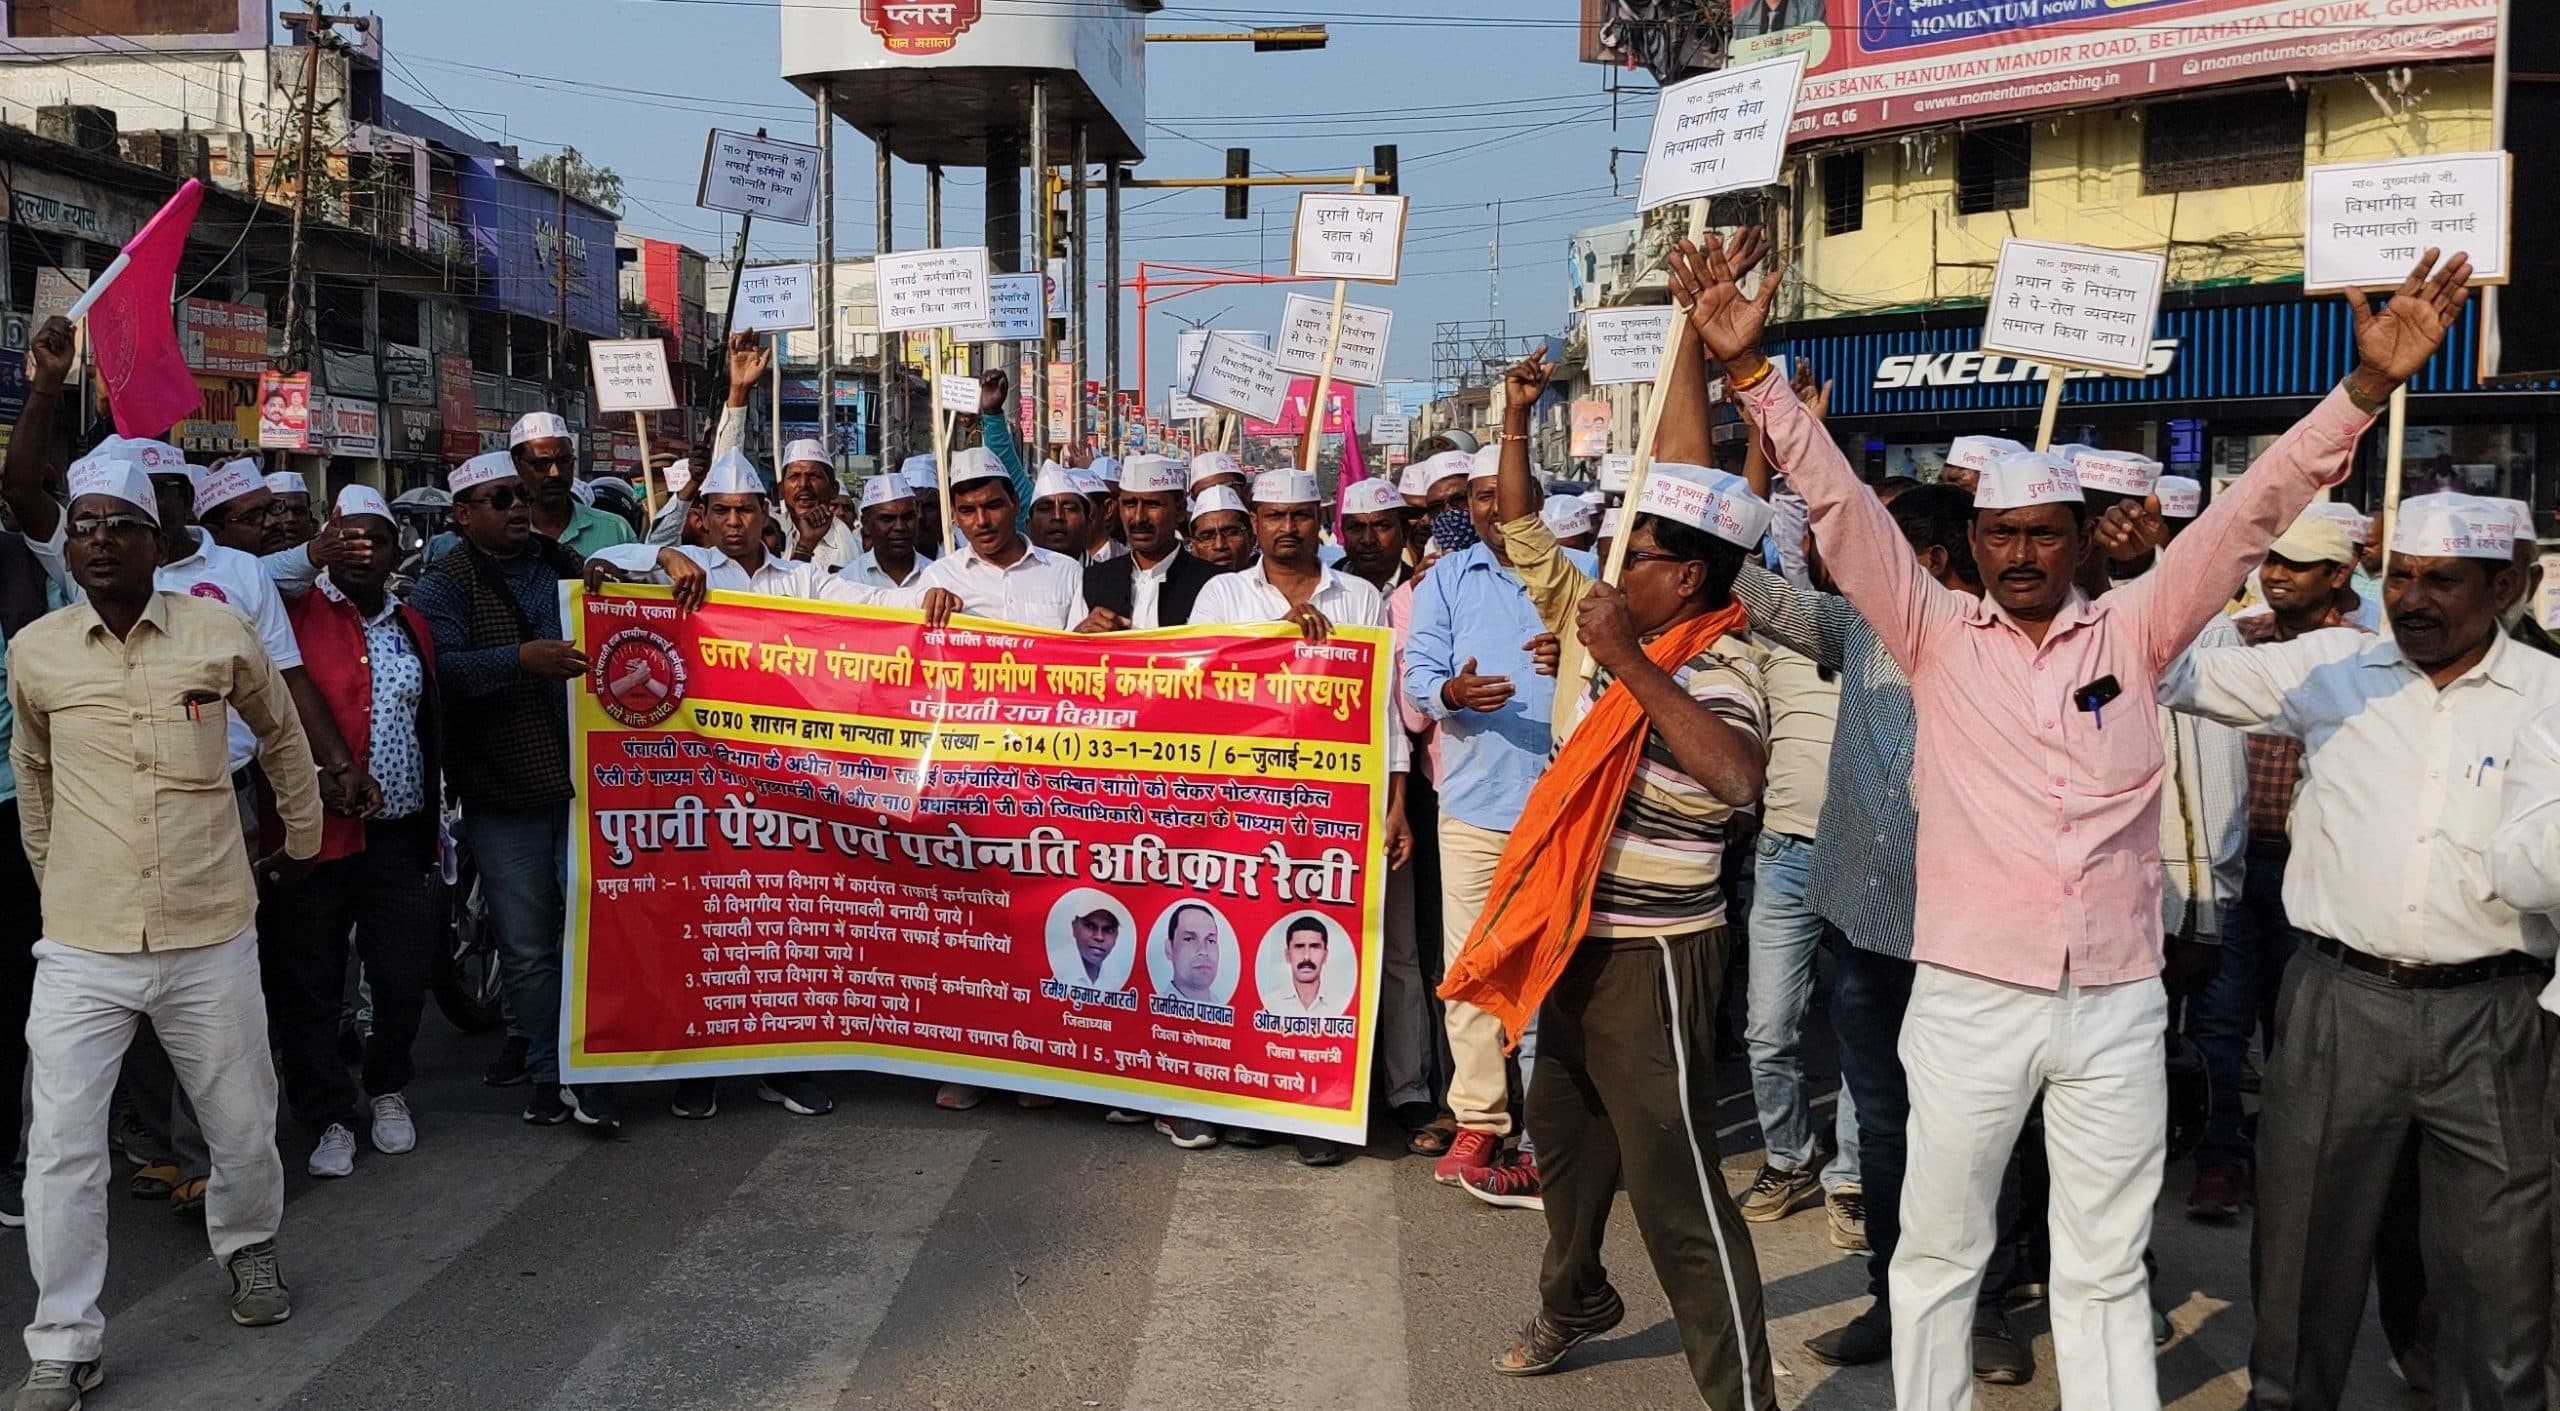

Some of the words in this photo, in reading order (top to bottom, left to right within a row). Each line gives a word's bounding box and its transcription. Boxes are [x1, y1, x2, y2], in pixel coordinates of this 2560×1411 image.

[882, 4, 958, 26] प्लस
[1910, 1, 2040, 37] MOMENTUM
[2042, 2, 2077, 16] NOW
[888, 38, 909, 48] पान
[915, 37, 952, 48] मसाला
[1804, 83, 1836, 103] AXIS
[1840, 75, 1889, 95] BANK,
[1894, 60, 1992, 88] HANUMAN
[1995, 46, 2071, 73] MANDIR
[2078, 37, 2142, 60] ROAD,
[2150, 15, 2271, 48] BETIAHATA
[2277, 3, 2377, 29] CHOWK,
[1677, 106, 1730, 132] विभागीय
[1737, 100, 1765, 118] सेवा
[1664, 129, 1726, 160] नियमावली
[1733, 119, 1768, 143] बनाई
[725, 160, 752, 175] सफाई
[790, 172, 802, 183] को
[2382, 173, 2432, 190] मुख्यमंत्री
[771, 182, 794, 196] किया
[2345, 194, 2417, 215] विभागीय
[2429, 190, 2465, 209] सेवा
[1316, 206, 1350, 226] पुरानी
[1356, 207, 1384, 224] पेंशन
[1359, 227, 1374, 243] की
[2333, 217, 2420, 240] नियमावली
[550, 225, 588, 261] MRTIA
[889, 272, 917, 287] सफाई
[922, 268, 973, 283] कर्मचारियों
[2060, 260, 2101, 275] मुख्यमंत्री
[893, 291, 906, 301] का
[937, 285, 971, 298] पंचायत
[2015, 274, 2052, 290] प्रधान
[2060, 276, 2077, 294] के
[2084, 280, 2137, 302] नियंत्रण
[890, 304, 916, 318] सेवक
[921, 302, 945, 314] किया
[2008, 292, 2021, 310] से
[2029, 294, 2076, 317] पे-रोल
[2084, 306, 2137, 326] व्यवस्था
[2001, 318, 2045, 335] समाप्त
[2053, 322, 2089, 342] किया
[1683, 502, 1710, 520] बहाल
[1718, 499, 1731, 513] जी
[588, 600, 638, 620] कर्मचारी
[640, 604, 677, 620] एकता
[1294, 641, 1359, 663] जिन्दाबाद
[698, 636, 753, 671] उत्तर
[758, 633, 818, 678] प्रदेश
[826, 643, 914, 688] पंचायती
[920, 658, 966, 692] राज
[971, 650, 1038, 694] ग्रामीण
[1043, 653, 1110, 702] सफाई
[1114, 655, 1205, 701] कर्मचारी
[1211, 662, 1257, 703] संघ
[1264, 661, 1365, 722] गोरखपुर
[909, 694, 1000, 722] पंचायती
[1003, 703, 1050, 725] राज
[1055, 699, 1138, 729] विभाग
[750, 713, 797, 737] शासन
[801, 718, 834, 742] द्वारा
[839, 722, 895, 747] मान्यता
[899, 729, 933, 750] प्राप्त
[940, 728, 980, 752] संख्या
[1053, 731, 1081, 762] (1)
[622, 735, 678, 759] पंचायती
[682, 741, 712, 758] राज
[712, 743, 761, 769] विभाग
[764, 751, 781, 770] के
[785, 752, 831, 778] अधीन
[837, 761, 887, 782] ग्रामीण
[892, 765, 940, 788] सफाई
[942, 765, 1020, 790] कर्मचारियों
[1024, 769, 1042, 790] के
[1045, 770, 1097, 793] लम्बित
[1143, 775, 1167, 799] को
[1172, 778, 1216, 801] लेकर
[1219, 780, 1332, 808] मोटरसाइकिल
[594, 792, 711, 866] पुरानी
[714, 790, 825, 852] पेंशन
[827, 814, 894, 862] एवं
[893, 822, 1081, 878] पदोन्नति
[1087, 832, 1265, 899] अधिकार
[1261, 839, 1361, 906] रैली
[597, 877, 630, 900] प्रमुख
[682, 875, 697, 891] 1.
[700, 868, 751, 892] पंचायती
[756, 873, 785, 890] राज
[788, 870, 829, 892] विभाग
[832, 872, 845, 893] में
[849, 874, 897, 896] कार्यरत
[899, 882, 939, 902] सफाई
[941, 887, 1011, 909] कर्मचारियों
[1040, 977, 1068, 1000] रमेश
[1070, 984, 1102, 1012] कुमार
[1103, 986, 1138, 1011] भारती
[1149, 992, 1196, 1020] राममिलन
[1196, 1002, 1235, 1027] पासवान
[1062, 1011, 1113, 1033] जिलाध्यक्ष
[1253, 1009, 1281, 1033] ओम
[1282, 1013, 1322, 1038] प्रकाश
[1322, 1016, 1356, 1039] यादव
[1265, 1041, 1296, 1060] जिला
[1298, 1043, 1343, 1064] महामंत्री
[1114, 1048, 1152, 1073] पुरानी
[1157, 1050, 1191, 1076] पेंशन
[1194, 1061, 1231, 1083] बहाल
[1233, 1063, 1270, 1089] किया
[1272, 1070, 1305, 1094] जाये
